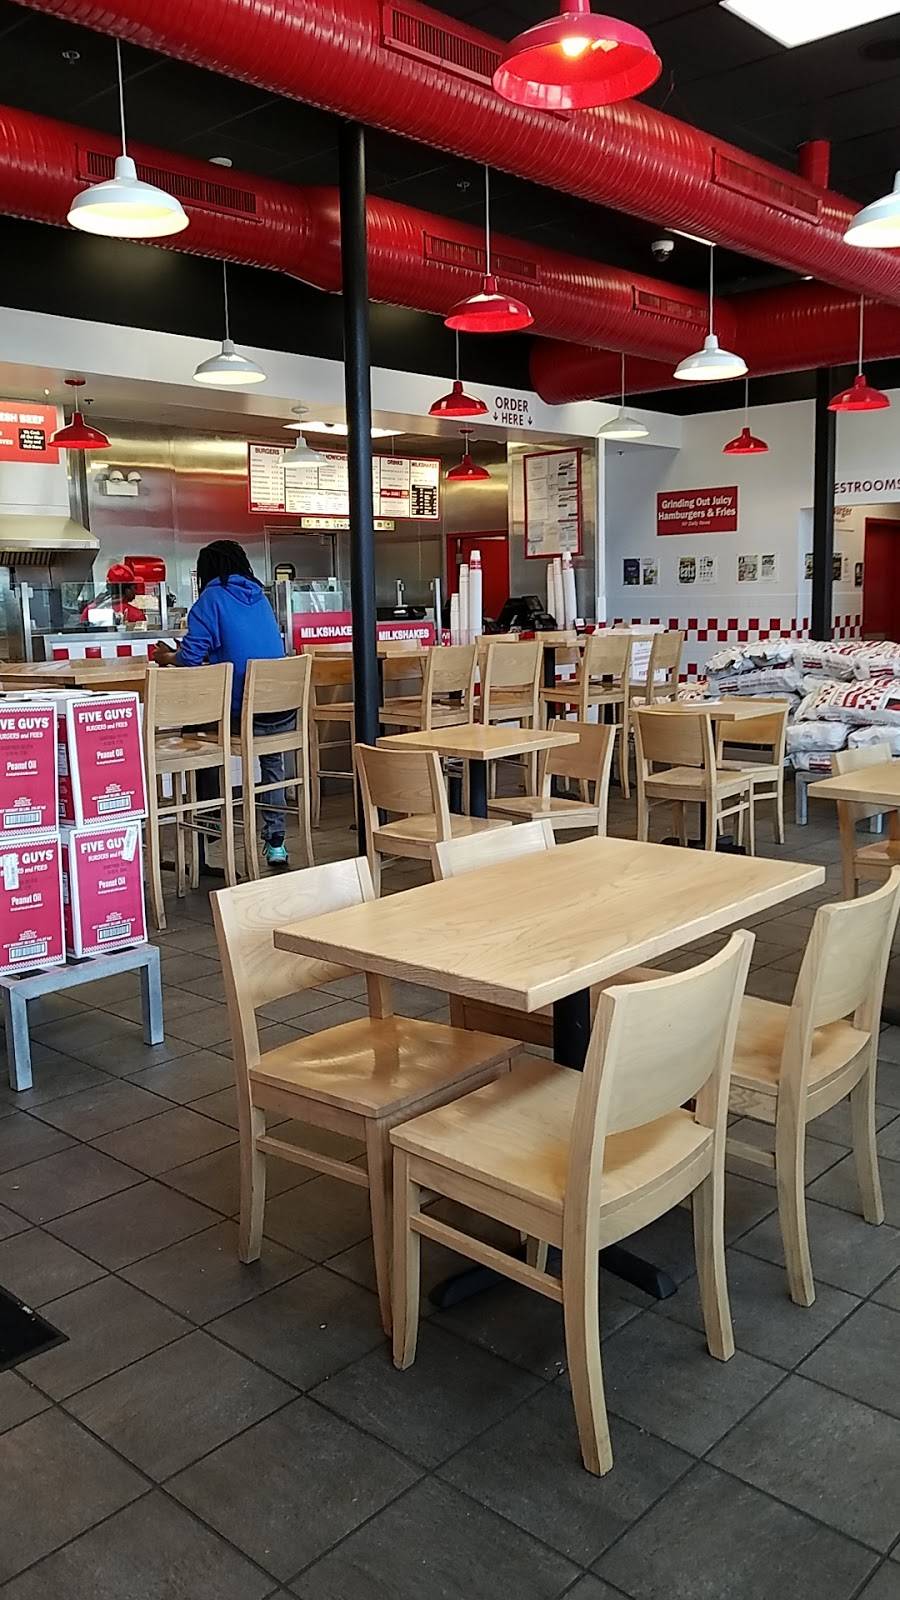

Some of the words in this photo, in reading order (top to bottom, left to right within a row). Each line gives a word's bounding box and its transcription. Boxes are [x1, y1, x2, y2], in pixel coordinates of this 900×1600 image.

[495, 396, 529, 413] ORDER
[501, 412, 524, 426] HERE
[255, 448, 280, 456] BURGERS
[833, 479, 900, 494] ESTROOM
[661, 497, 695, 510] Grinding
[696, 497, 711, 506] Out
[711, 495, 733, 506] Juicy
[658, 508, 705, 521] Hamburgers
[706, 508, 714, 518] &
[715, 506, 737, 517] Fries
[301, 626, 352, 639] MILKSHAKE
[378, 628, 430, 641] MILKSHAKES
[0, 718, 15, 730] VE
[17, 716, 49, 730] GUYS
[78, 711, 103, 724] FIVE
[104, 708, 132, 722] GUYS
[29, 731, 43, 739] FRIES
[96, 749, 115, 760] Peanut
[115, 748, 124, 758] Oil
[6, 760, 27, 771] Peanut
[28, 760, 37, 770] Oil
[80, 840, 105, 854] FIVE
[106, 837, 127, 850] GUY
[22, 849, 54, 864] GUYS
[25, 866, 33, 874] and
[33, 864, 48, 872] FRIES
[98, 878, 117, 889] Peanut
[118, 876, 126, 887] Oil
[11, 894, 32, 906] Peanut
[32, 892, 42, 903] Oil
